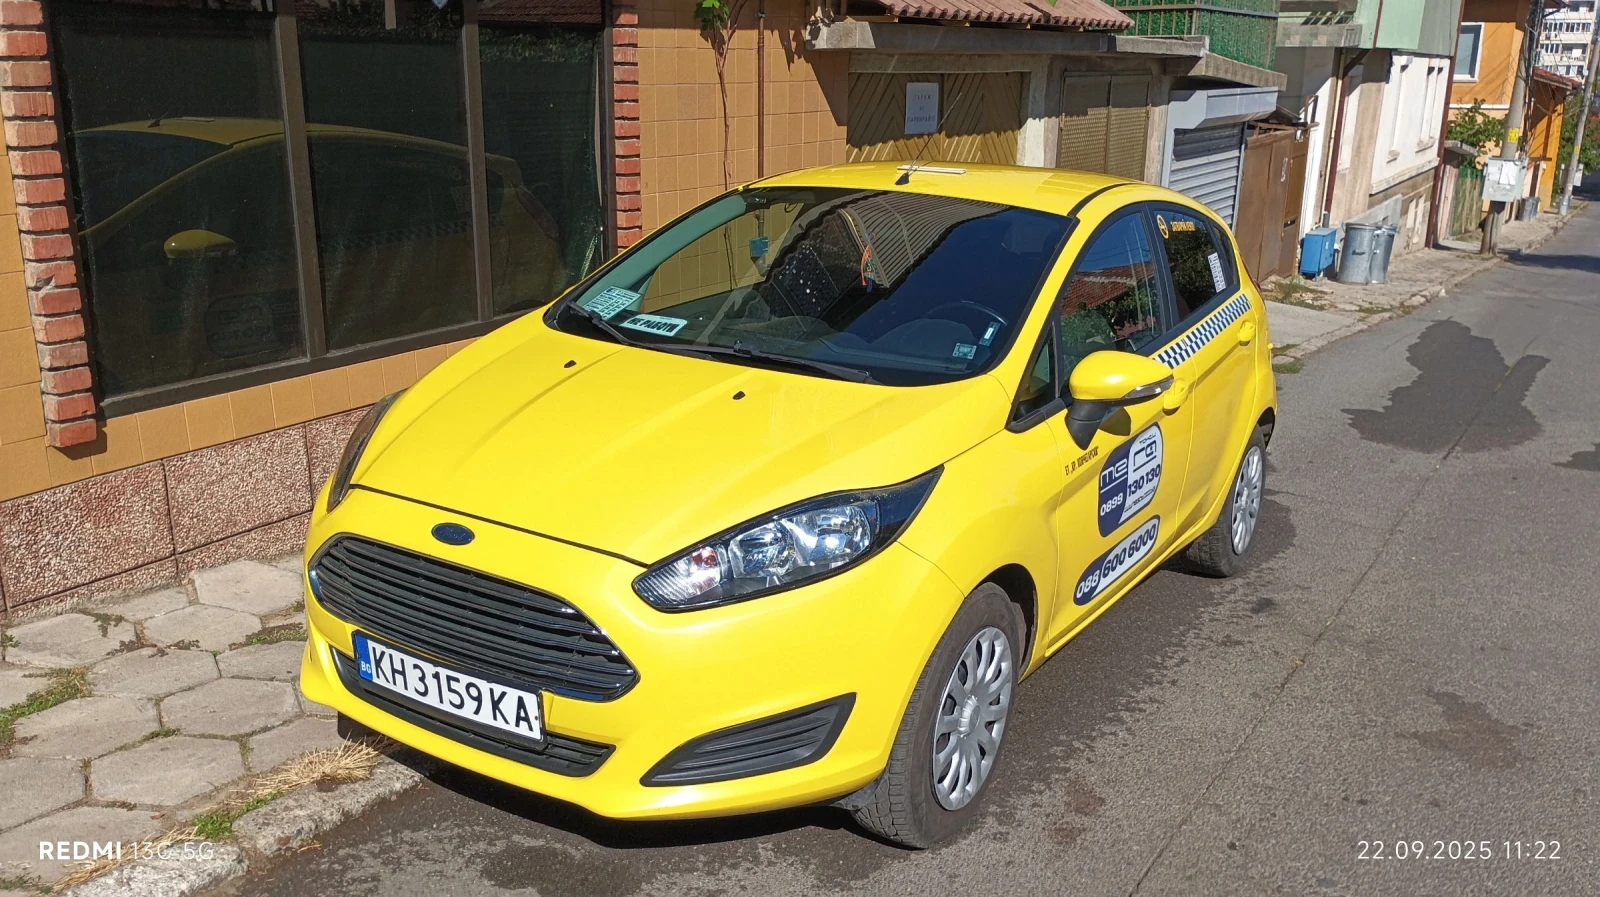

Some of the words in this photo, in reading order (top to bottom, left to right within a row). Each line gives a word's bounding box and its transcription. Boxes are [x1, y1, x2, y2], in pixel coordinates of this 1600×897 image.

[1100, 493, 1124, 516] 0899
[1127, 475, 1144, 497] 130
[1145, 464, 1161, 485] 130
[1076, 569, 1100, 598] 088
[1102, 547, 1126, 578] 600
[1127, 523, 1156, 558] 6000
[361, 661, 372, 674] BG
